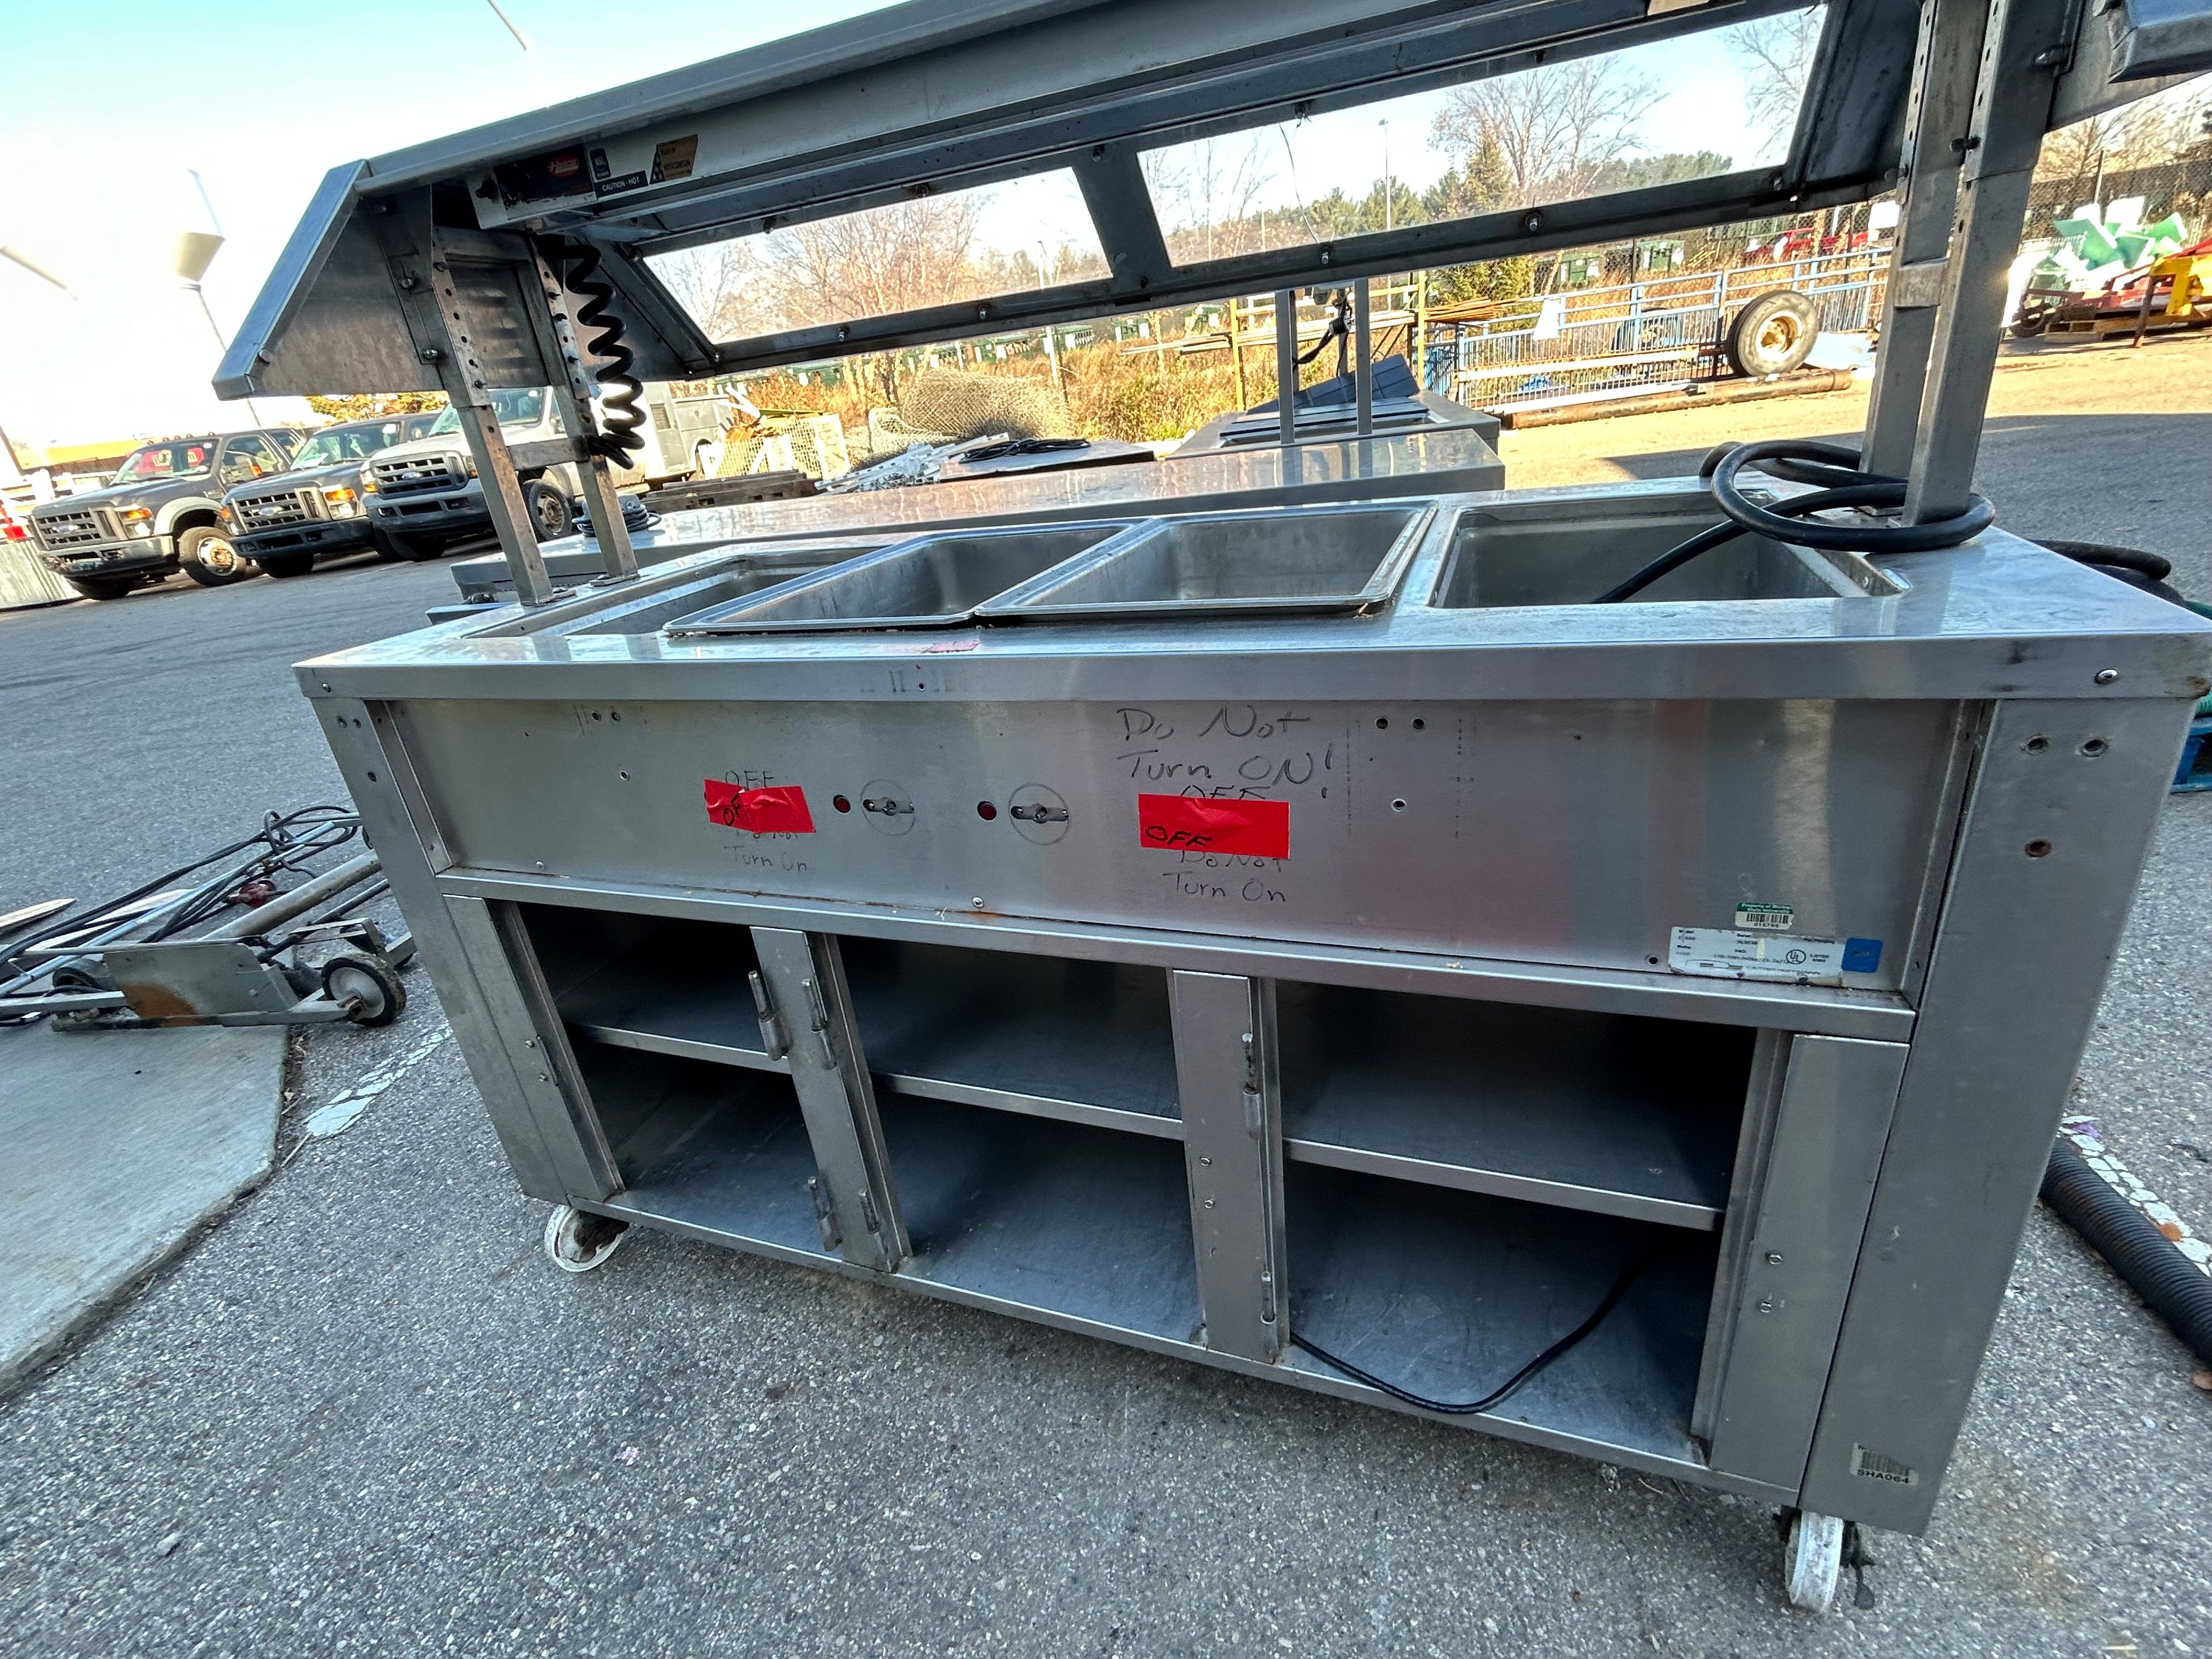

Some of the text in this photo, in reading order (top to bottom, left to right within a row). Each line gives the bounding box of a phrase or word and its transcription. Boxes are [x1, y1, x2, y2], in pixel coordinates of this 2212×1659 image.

[602, 180, 625, 191] CAUTION
[629, 176, 640, 185] HOT
[1116, 704, 1311, 741] Do Not
[1116, 749, 1211, 781] Turn
[725, 770, 775, 792] OFF
[1144, 825, 1212, 847] OFF
[724, 845, 808, 872] Turn On
[1163, 870, 1286, 902] Turn On
